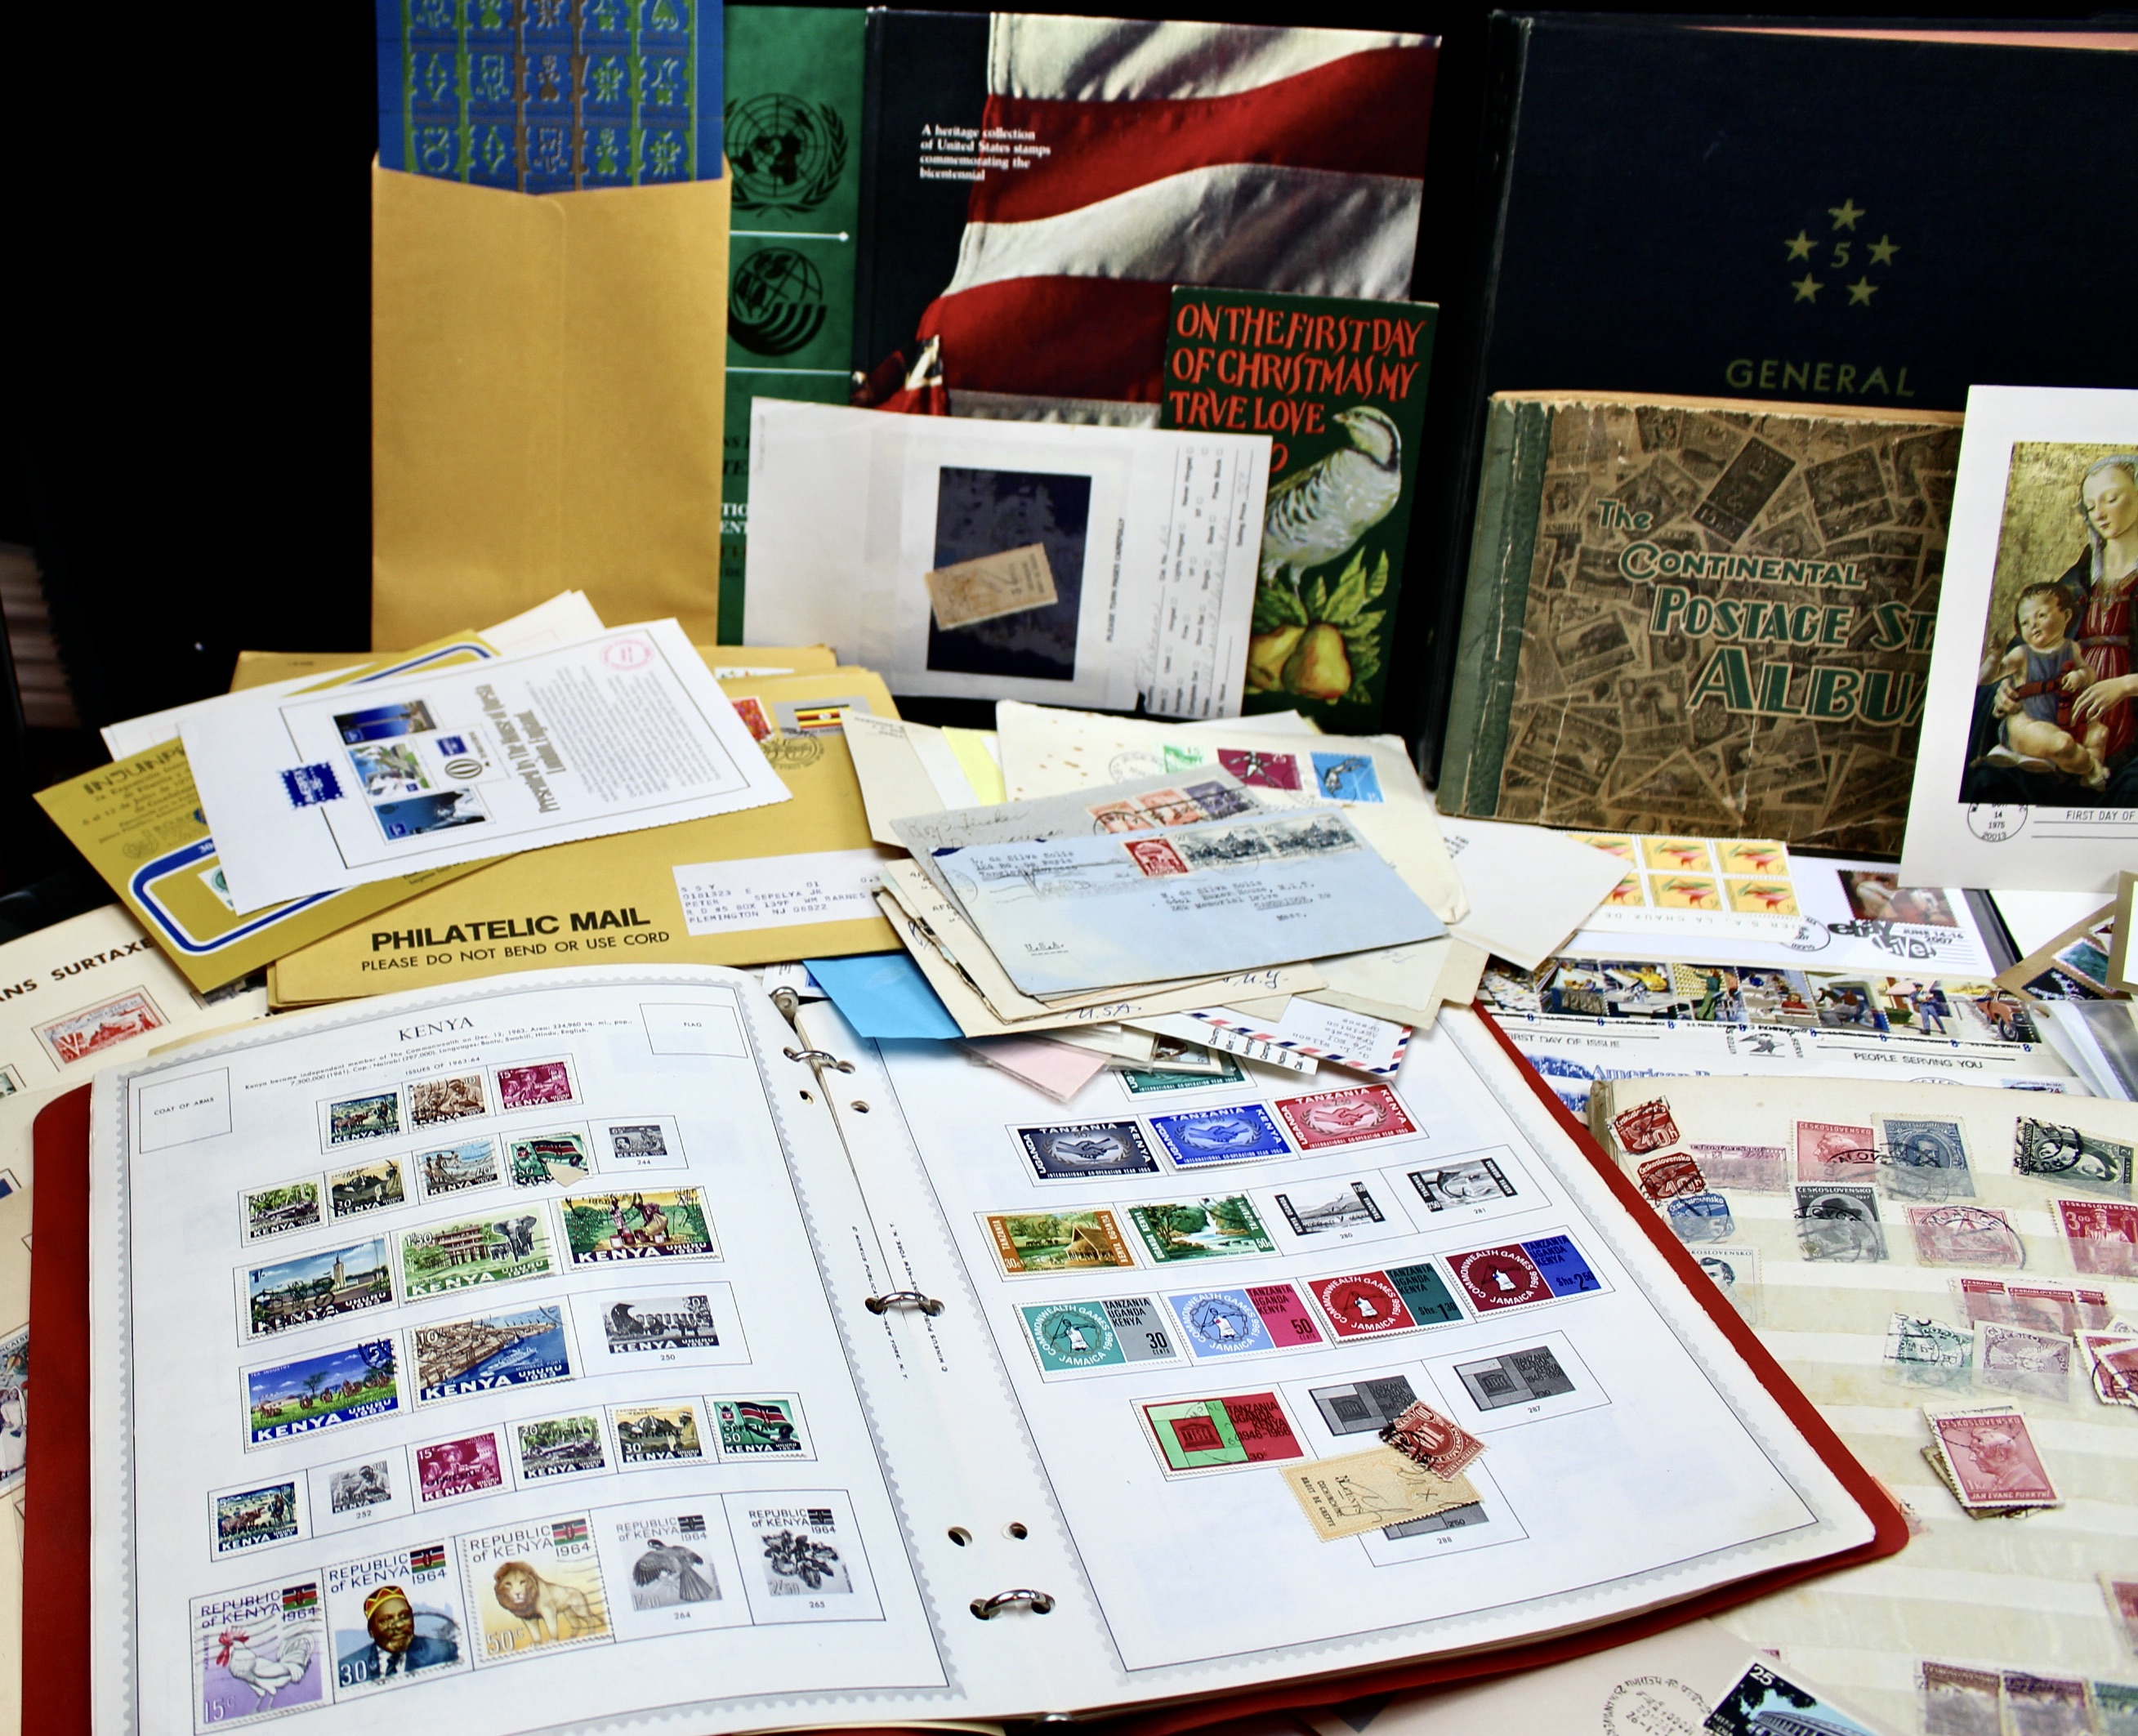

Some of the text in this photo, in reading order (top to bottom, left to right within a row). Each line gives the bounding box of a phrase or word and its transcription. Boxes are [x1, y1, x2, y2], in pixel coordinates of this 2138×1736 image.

[921, 123, 1036, 141] A heritage collection
[919, 138, 1051, 158] of United States stamps
[919, 154, 1031, 171] commemorating the
[919, 165, 985, 181] bicentennial
[1830, 241, 1852, 270] 5
[1175, 300, 1428, 359] ON THE FIRST DAY
[1172, 346, 1421, 402] OF CHRISTMAS MY
[1725, 358, 1916, 398] GENERAL
[1252, 395, 1326, 437] LOVE
[1596, 498, 1654, 531] The
[1649, 583, 1856, 648] POSTAGE
[1993, 810, 2002, 819] 14
[2066, 810, 2135, 821] FIRST DAY OF
[1988, 820, 2006, 829] 1975
[1981, 831, 2007, 841] 20013
[685, 888, 824, 908] PETER SEPELYA JR
[736, 903, 756, 911] BOX
[824, 892, 867, 903] BARNES
[689, 911, 759, 924] FLEMINGTON
[771, 907, 787, 915] NJ
[372, 907, 651, 952] PHILATELIC MAIL
[361, 930, 670, 972] PLEASE DO NOT BEND OR USE CORD
[398, 1015, 475, 1042] KENYA
[682, 1020, 703, 1029] FLAG
[373, 1056, 401, 1069] Nairobi
[439, 1041, 480, 1055] Languages:
[534, 1029, 560, 1039] Hindu,
[1539, 1035, 1562, 1045] DAY
[1566, 1037, 1582, 1046] OF
[1587, 1038, 1620, 1048] ISSUE
[244, 1081, 268, 1091] Kenya
[270, 1074, 297, 1085] became
[300, 1064, 346, 1079] independent
[347, 1055, 376, 1067] member
[378, 1053, 388, 1061] of
[390, 1050, 404, 1060] The
[405, 1038, 460, 1055] Commonwealth
[474, 1033, 491, 1042] Dec.
[404, 1064, 431, 1077] ISSUES
[433, 1062, 445, 1071] OF
[1853, 1052, 1984, 1069] PEOPLE SERVING YOU
[1294, 1087, 1371, 1105] TANZANIA
[154, 1096, 215, 1117] COAT OF ARMS
[1169, 1106, 1246, 1122] TANZANIA
[1380, 1088, 1408, 1125] KENYA
[1038, 1122, 1118, 1136] TANZANIA
[1280, 1105, 1309, 1146] UGANDA
[1154, 1122, 1183, 1162] UGANDA
[1308, 1137, 1347, 1149] INTERNATIONAL
[1381, 1129, 1395, 1139] YEAR
[1395, 1127, 1408, 1135] 1965
[636, 1158, 652, 1167] 244
[1022, 1132, 1047, 1175] UGANDA
[1473, 1207, 1488, 1216] 281
[1339, 1231, 1354, 1240] 280
[1460, 1249, 1534, 1299] COMMONWEALTH GAMES
[1246, 1285, 1295, 1298] TANZANIA
[1489, 1270, 1540, 1305] JAMAICA 1966
[1102, 1297, 1152, 1310] TANZANIA
[1251, 1294, 1291, 1307] UGANDA
[1322, 1275, 1397, 1324] COMMONWEALTH GAMES
[1107, 1306, 1148, 1319] UGANDA
[1181, 1292, 1257, 1344] COMMONWEALTH GAMES
[1350, 1298, 1402, 1332] JAMAICA 1966
[1033, 1304, 1111, 1357] COMMONWEALTH GAMES
[1208, 1318, 1261, 1353] JAMAICA 1966
[1290, 1317, 1314, 1336] 50
[613, 1339, 676, 1354] KENYA
[1058, 1331, 1114, 1367] JAMAICA 1966
[1145, 1331, 1169, 1350] 30
[659, 1353, 676, 1362] 250
[1151, 1347, 1171, 1356] CENTS
[518, 1363, 563, 1380] UHURU
[425, 1375, 513, 1400] KENYA
[347, 1398, 392, 1417] UHURU
[1527, 1404, 1542, 1414] 287
[256, 1413, 342, 1442] KENYA
[1971, 1492, 1987, 1500] JAN
[1988, 1491, 2015, 1499] EVANG
[355, 1510, 373, 1520] 252
[748, 1507, 807, 1520] REPUBLIC
[468, 1524, 551, 1551] REPUBLIC
[810, 1524, 837, 1534] 1964
[471, 1537, 555, 1564] of KENYA
[555, 1541, 592, 1559] 1964
[1436, 1536, 1453, 1546] 288
[328, 1552, 409, 1582] REPUBLIC
[329, 1567, 410, 1594] of KENYA
[412, 1568, 448, 1586] 1964
[200, 1589, 281, 1617] REPUBLIC
[807, 1600, 827, 1609] 265
[281, 1606, 318, 1623] 1964
[672, 1611, 692, 1621] 264
[1748, 1665, 1776, 1686] 25
